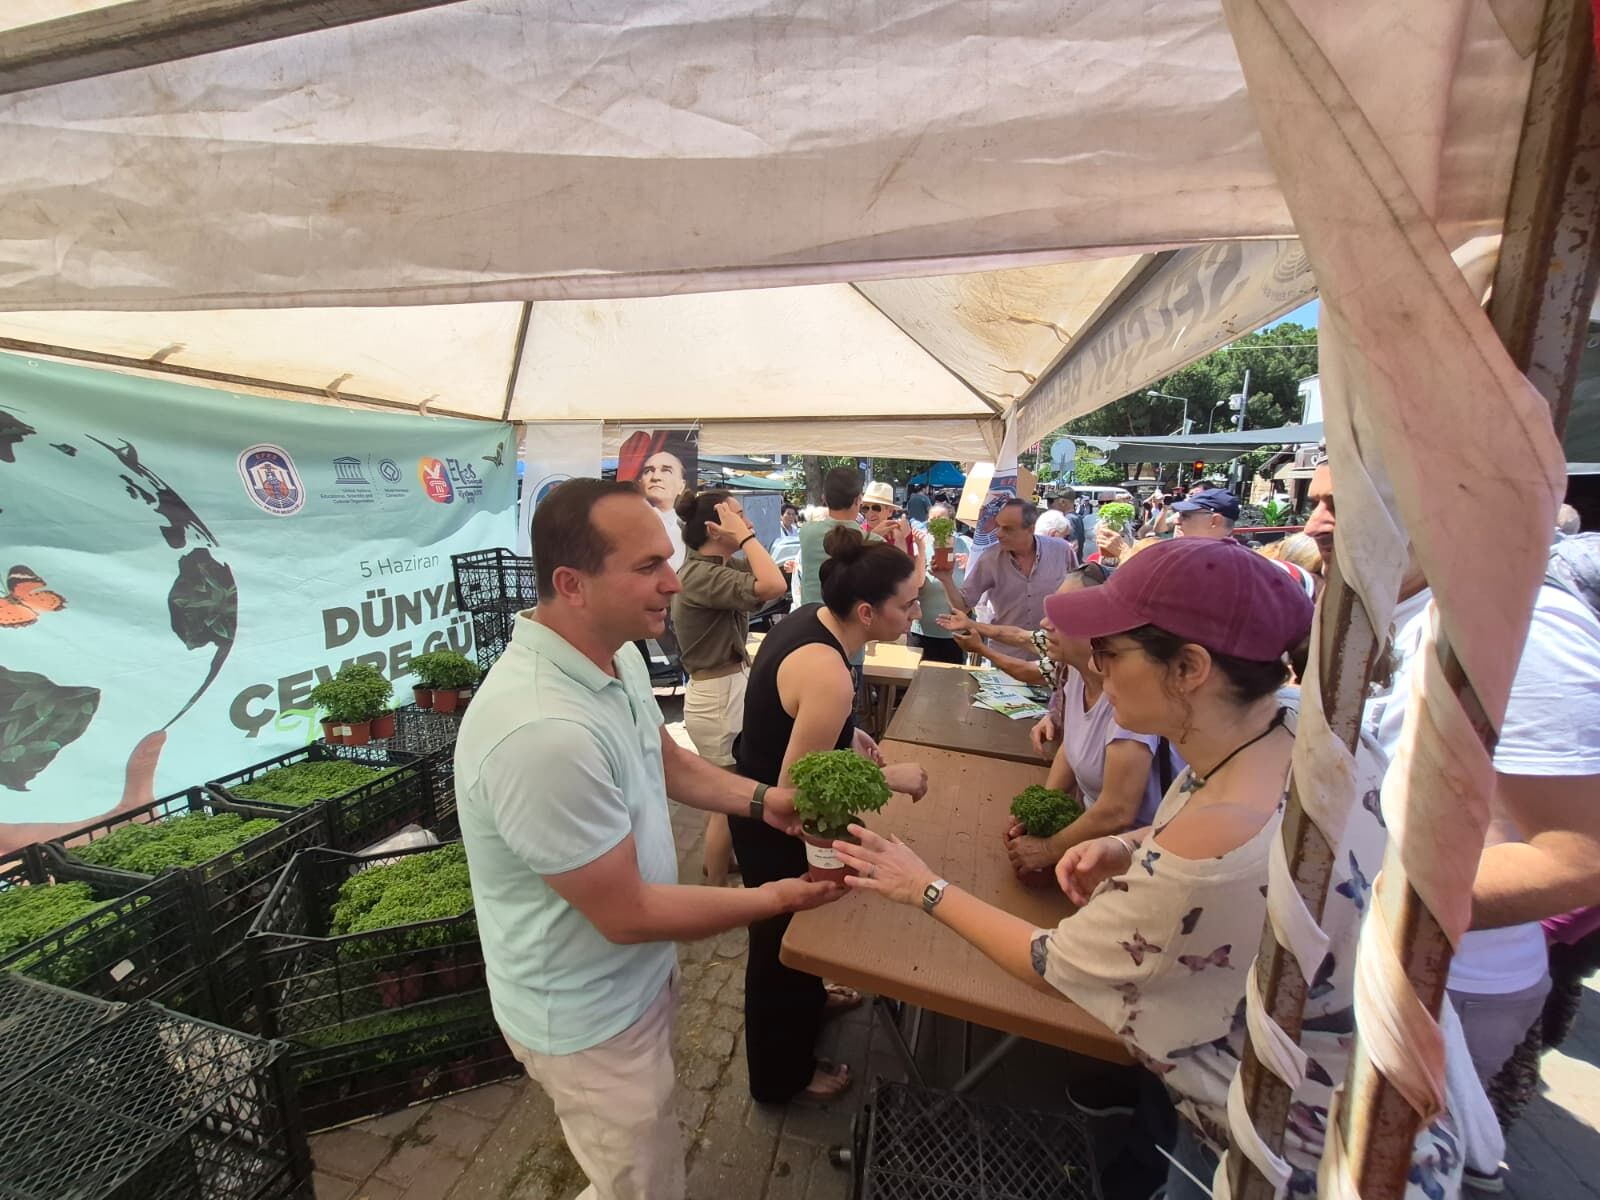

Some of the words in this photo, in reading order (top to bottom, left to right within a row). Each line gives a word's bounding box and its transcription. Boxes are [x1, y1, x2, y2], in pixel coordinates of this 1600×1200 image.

[360, 560, 372, 578] 5
[378, 554, 439, 575] Haziran
[322, 581, 459, 650] DÜNYA
[422, 615, 473, 656] GÜ
